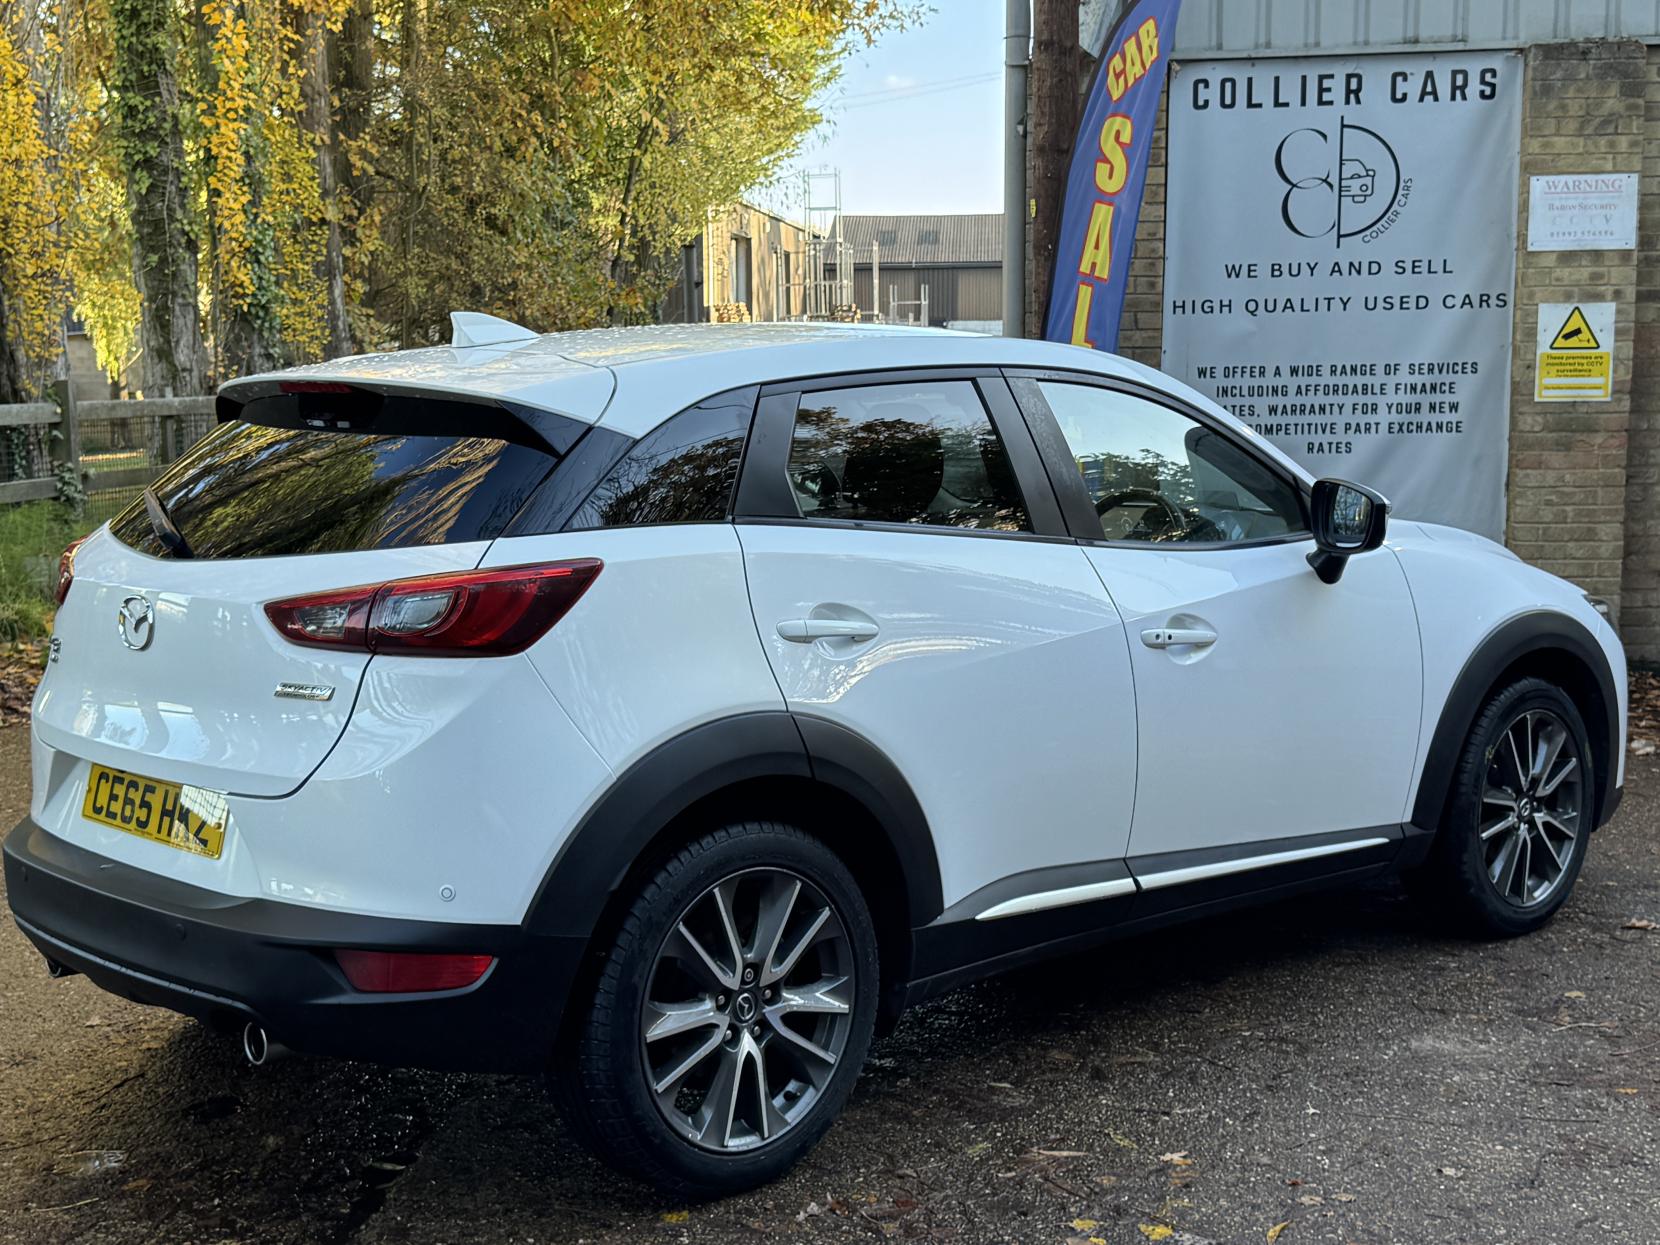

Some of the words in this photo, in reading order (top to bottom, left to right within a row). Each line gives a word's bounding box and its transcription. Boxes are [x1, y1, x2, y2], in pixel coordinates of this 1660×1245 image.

[1107, 17, 1159, 100] CAR
[1193, 73, 1363, 110] COLLIER
[1390, 68, 1497, 104] CARS
[1545, 178, 1623, 192] WARNING
[1361, 209, 1401, 244] COLLIER
[1396, 177, 1413, 207] CARS
[1071, 112, 1133, 349] SAL
[1225, 264, 1258, 279] WE
[1271, 262, 1319, 278] BUY
[1329, 261, 1381, 277] AND
[1394, 259, 1453, 275] SELL
[1173, 299, 1232, 315] HIGH
[1245, 297, 1352, 317] QUALITY
[1364, 295, 1429, 311] USED
[1442, 293, 1507, 309] CARS
[1197, 366, 1216, 379] WE
[1224, 366, 1266, 379] OFFER
[1273, 365, 1282, 378] A
[1290, 364, 1323, 377] WIDE
[1330, 364, 1376, 376] RANGE
[1384, 363, 1400, 376] OF
[1408, 362, 1478, 375] SERVICES
[1216, 385, 1288, 398] INCLUDING
[1295, 383, 1387, 397] AFFORDABLE
[1395, 382, 1456, 395] FINANCE
[1268, 403, 1345, 416] WARRANTY
[1352, 403, 1378, 415] FOR
[1386, 402, 1422, 415] YOUR
[1429, 401, 1459, 414] NEW
[1344, 423, 1381, 435] PART
[1388, 421, 1463, 434] EXCHANGE
[1307, 441, 1352, 454] RATES
[92, 771, 157, 830] CE65
